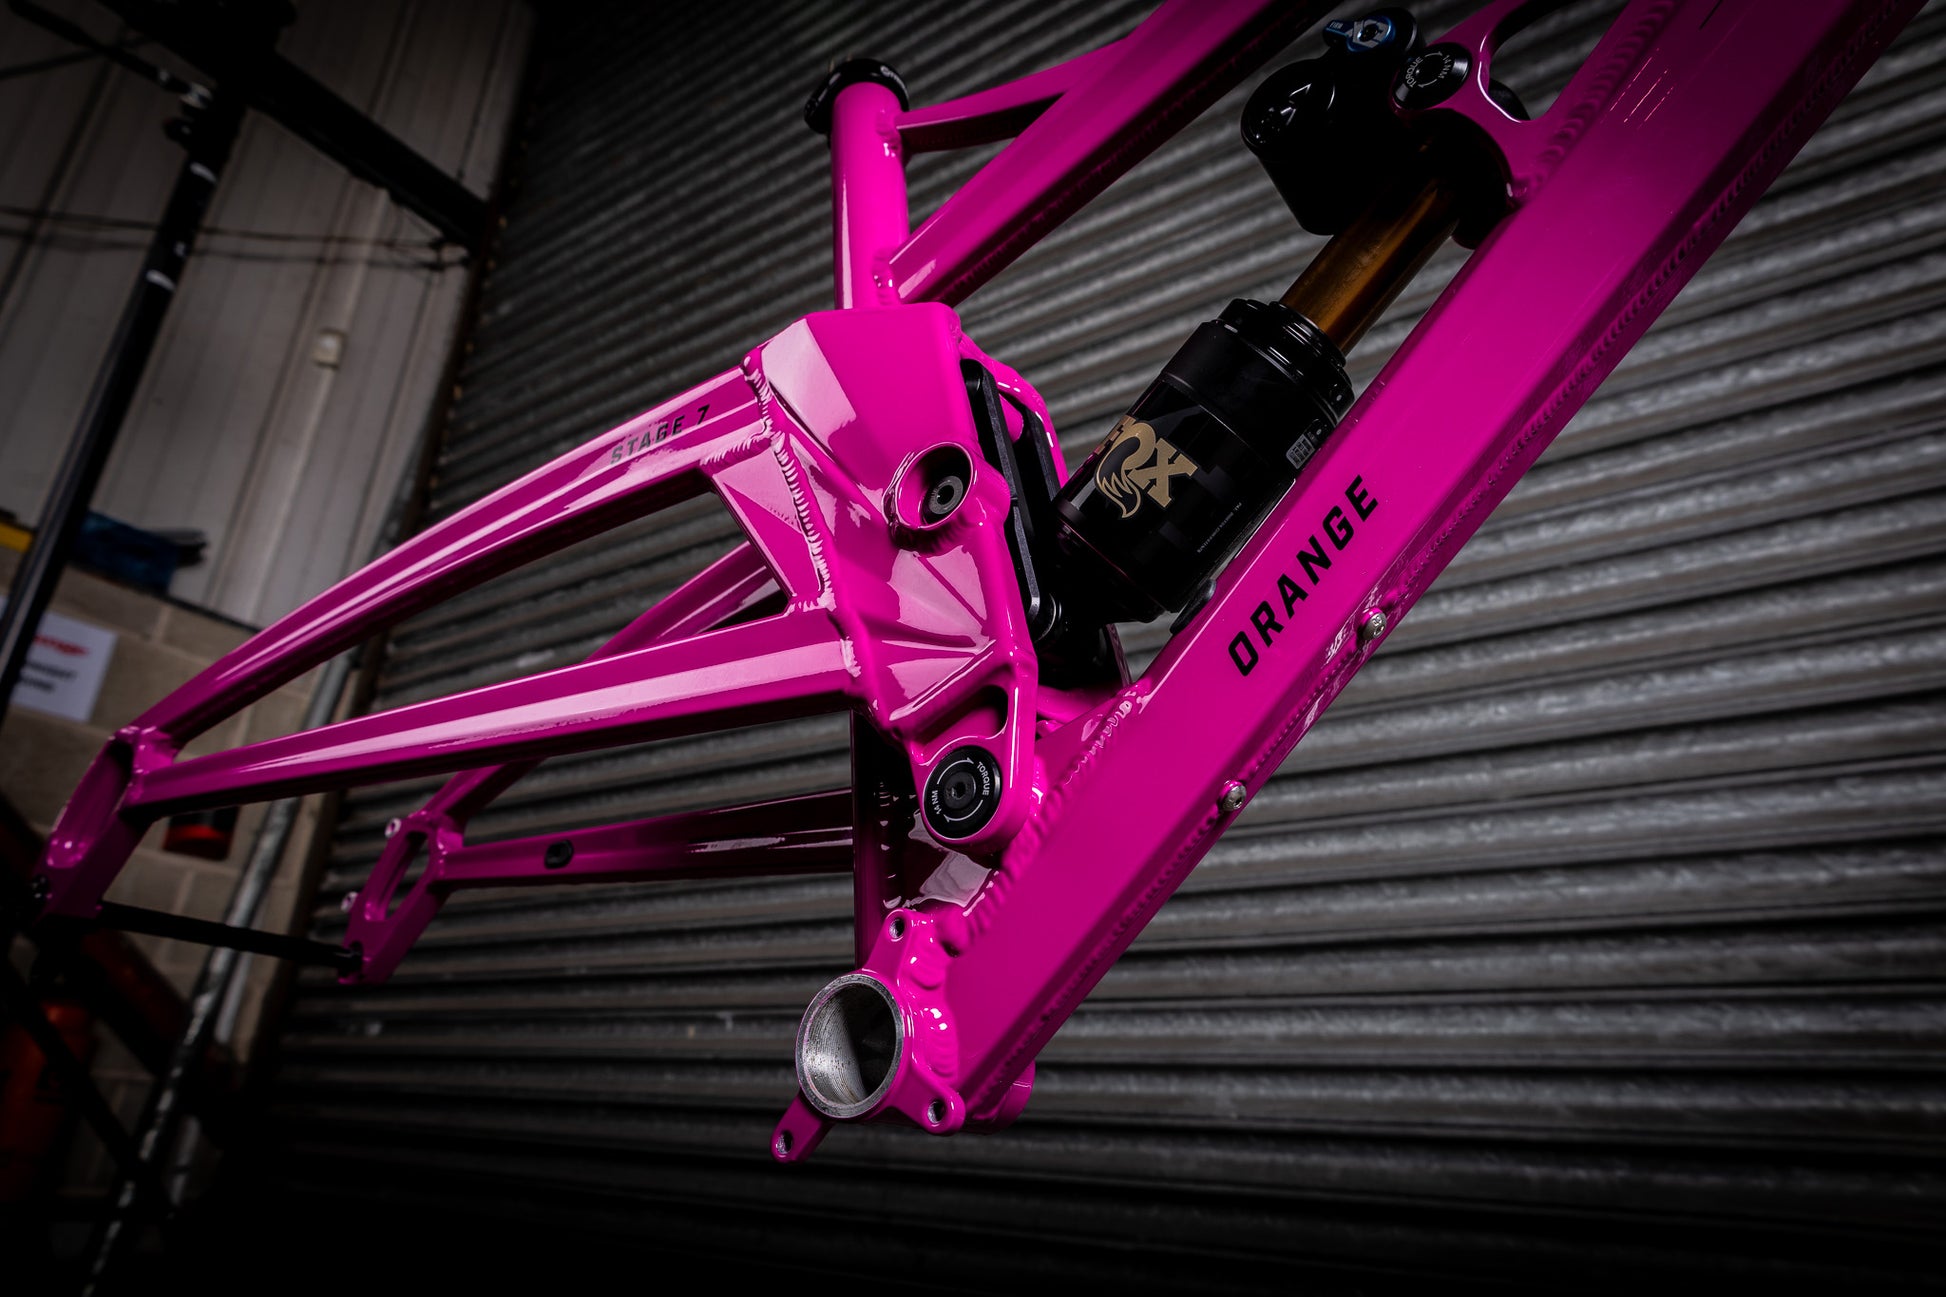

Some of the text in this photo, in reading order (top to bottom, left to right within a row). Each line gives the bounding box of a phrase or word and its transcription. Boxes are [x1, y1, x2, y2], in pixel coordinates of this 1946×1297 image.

[1405, 56, 1424, 88] TORQUE
[610, 404, 710, 465] STAGE 7
[1228, 474, 1378, 677] ORANGE
[976, 761, 991, 796] TORQUE
[931, 789, 939, 805] NM
